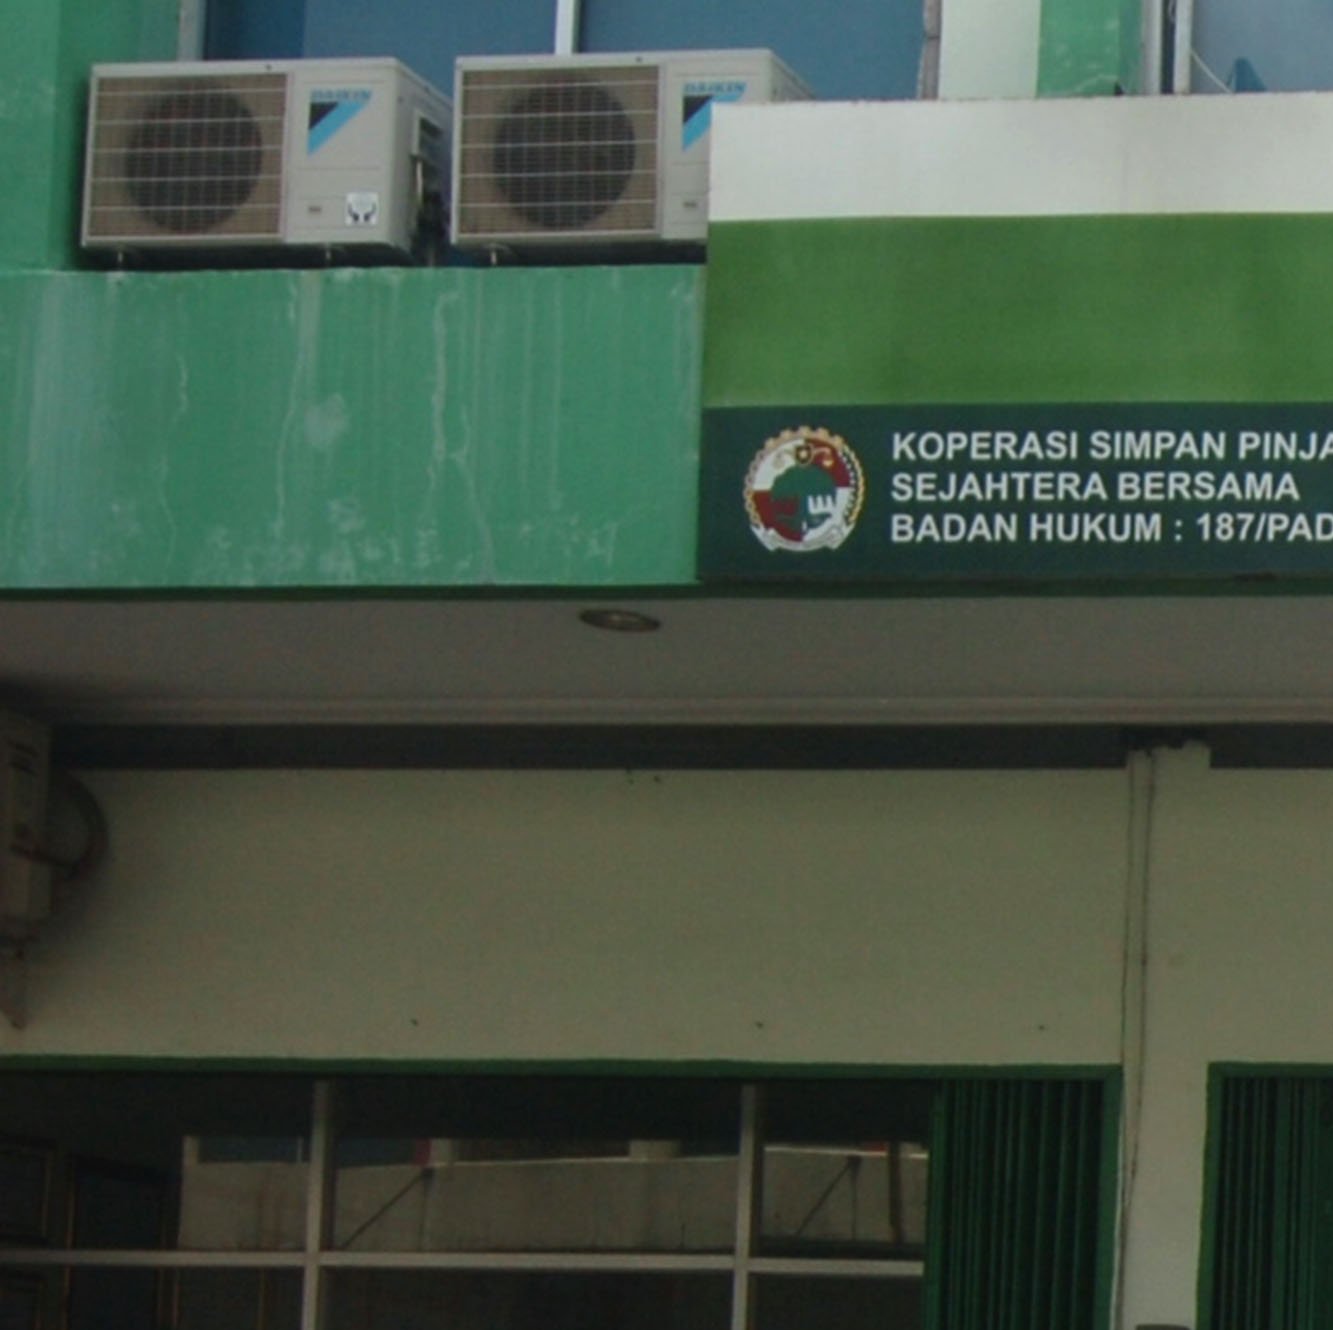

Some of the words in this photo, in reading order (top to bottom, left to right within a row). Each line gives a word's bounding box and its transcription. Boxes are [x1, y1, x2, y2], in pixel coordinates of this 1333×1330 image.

[891, 429, 1078, 462] KOPERASI
[1089, 429, 1226, 461] SIMPAN
[890, 471, 1108, 503] SEJAHTERA
[1117, 470, 1301, 502] BERSAMA
[890, 513, 1017, 542] BADAN
[1029, 512, 1163, 542] HUKUM
[1174, 519, 1183, 541] :
